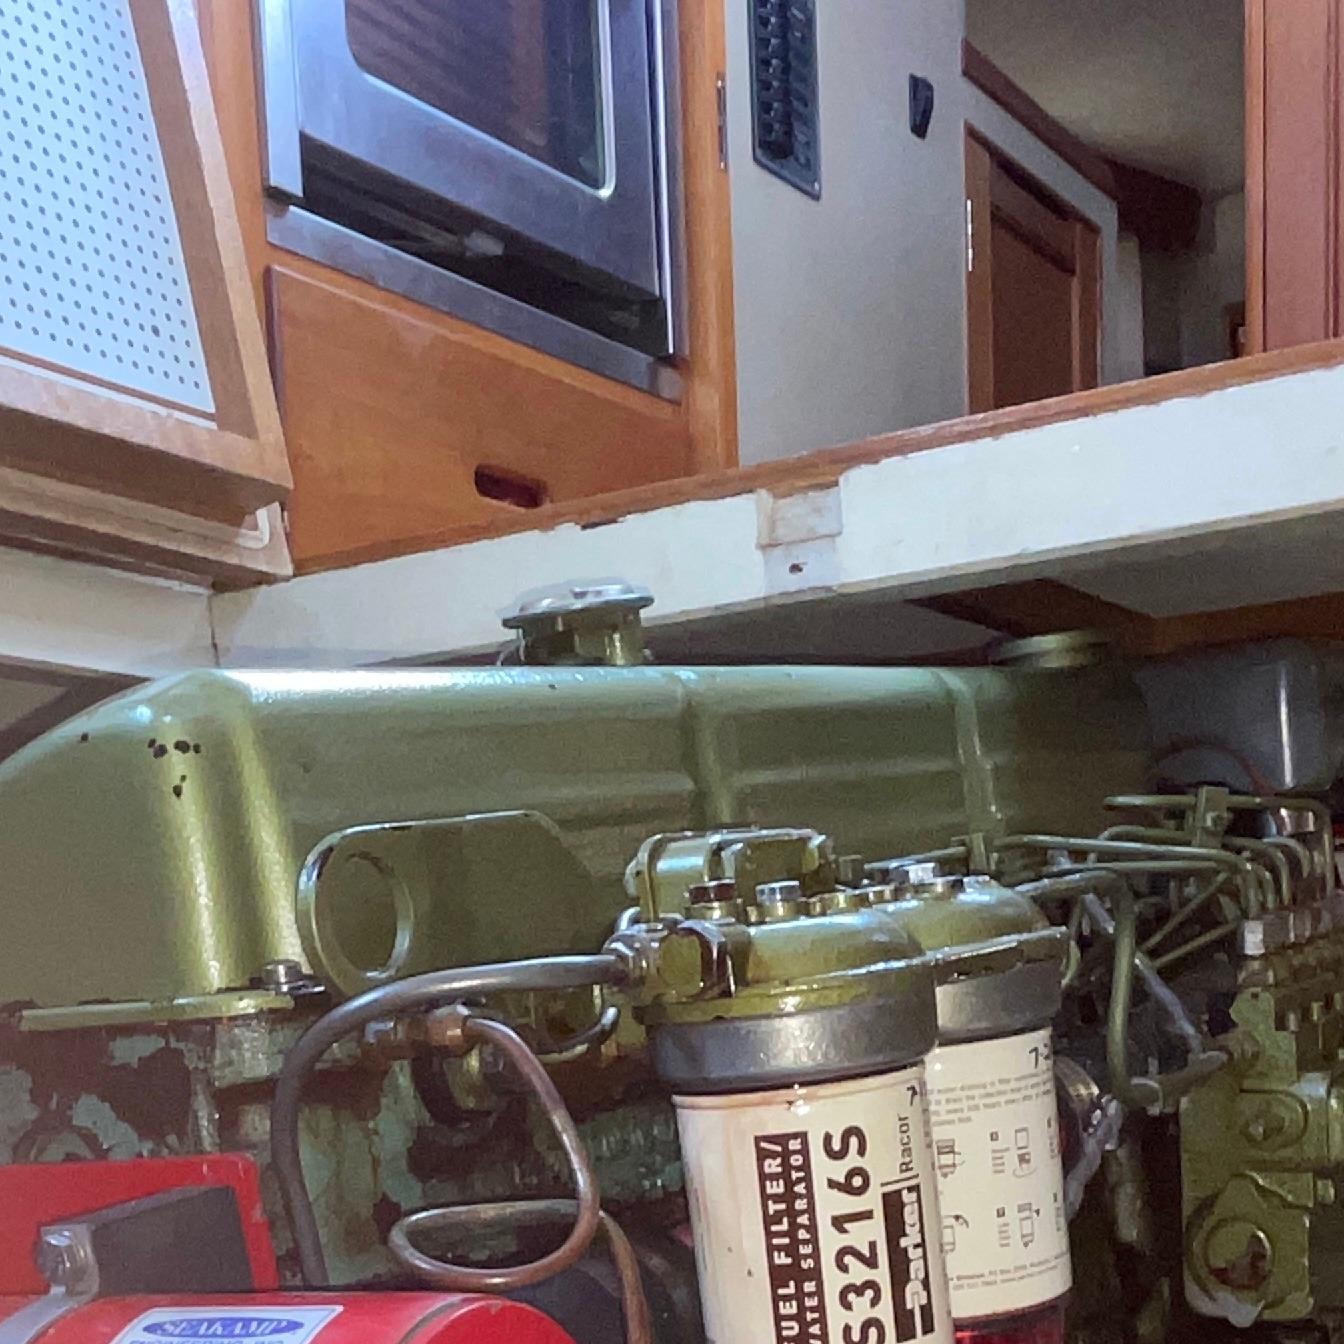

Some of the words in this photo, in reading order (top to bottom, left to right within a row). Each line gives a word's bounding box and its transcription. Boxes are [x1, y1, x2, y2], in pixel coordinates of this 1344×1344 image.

[760, 1140, 792, 1266] FILTER/
[788, 1137, 814, 1270] SEPARATOR
[897, 1113, 915, 1174] Racor
[899, 1188, 928, 1310] Parker
